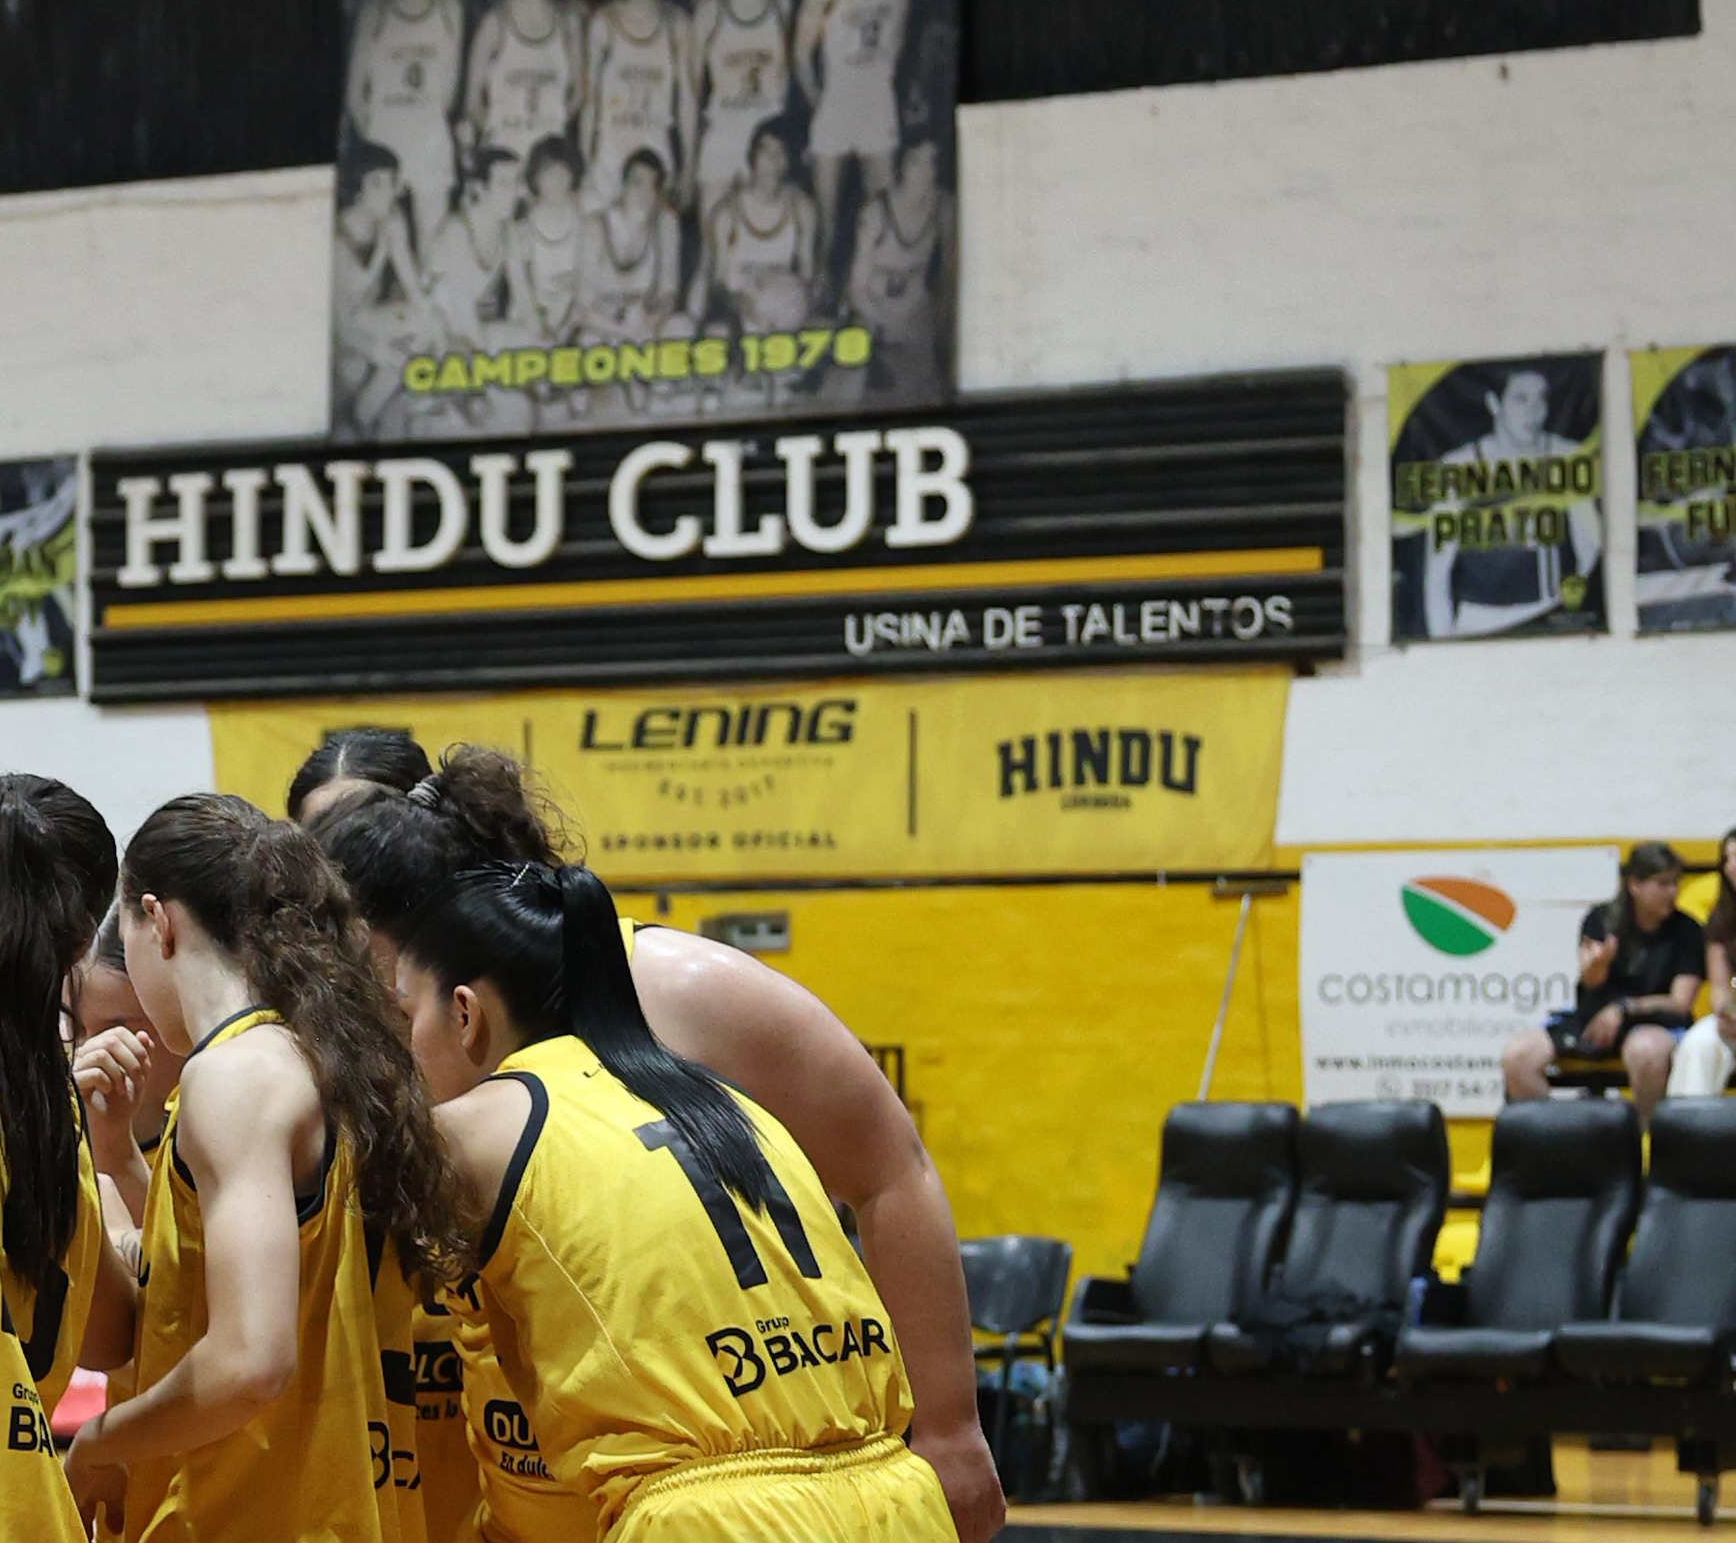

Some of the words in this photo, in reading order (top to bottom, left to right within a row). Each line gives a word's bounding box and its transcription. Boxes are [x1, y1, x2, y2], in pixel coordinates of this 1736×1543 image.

[404, 339, 728, 393] CAMPEONES
[117, 449, 573, 588] HINDU
[608, 426, 974, 561] CLUB
[1397, 457, 1596, 507] FERNANDO
[1434, 505, 1561, 554] PRATO
[844, 609, 970, 656] USINA
[983, 606, 1043, 649] DE
[1061, 595, 1294, 645] TALENTOS
[997, 727, 1202, 798] HINDU
[1318, 972, 1576, 1013] costamagn
[763, 1318, 891, 1376] BACAR
[7, 1406, 59, 1458] BA
